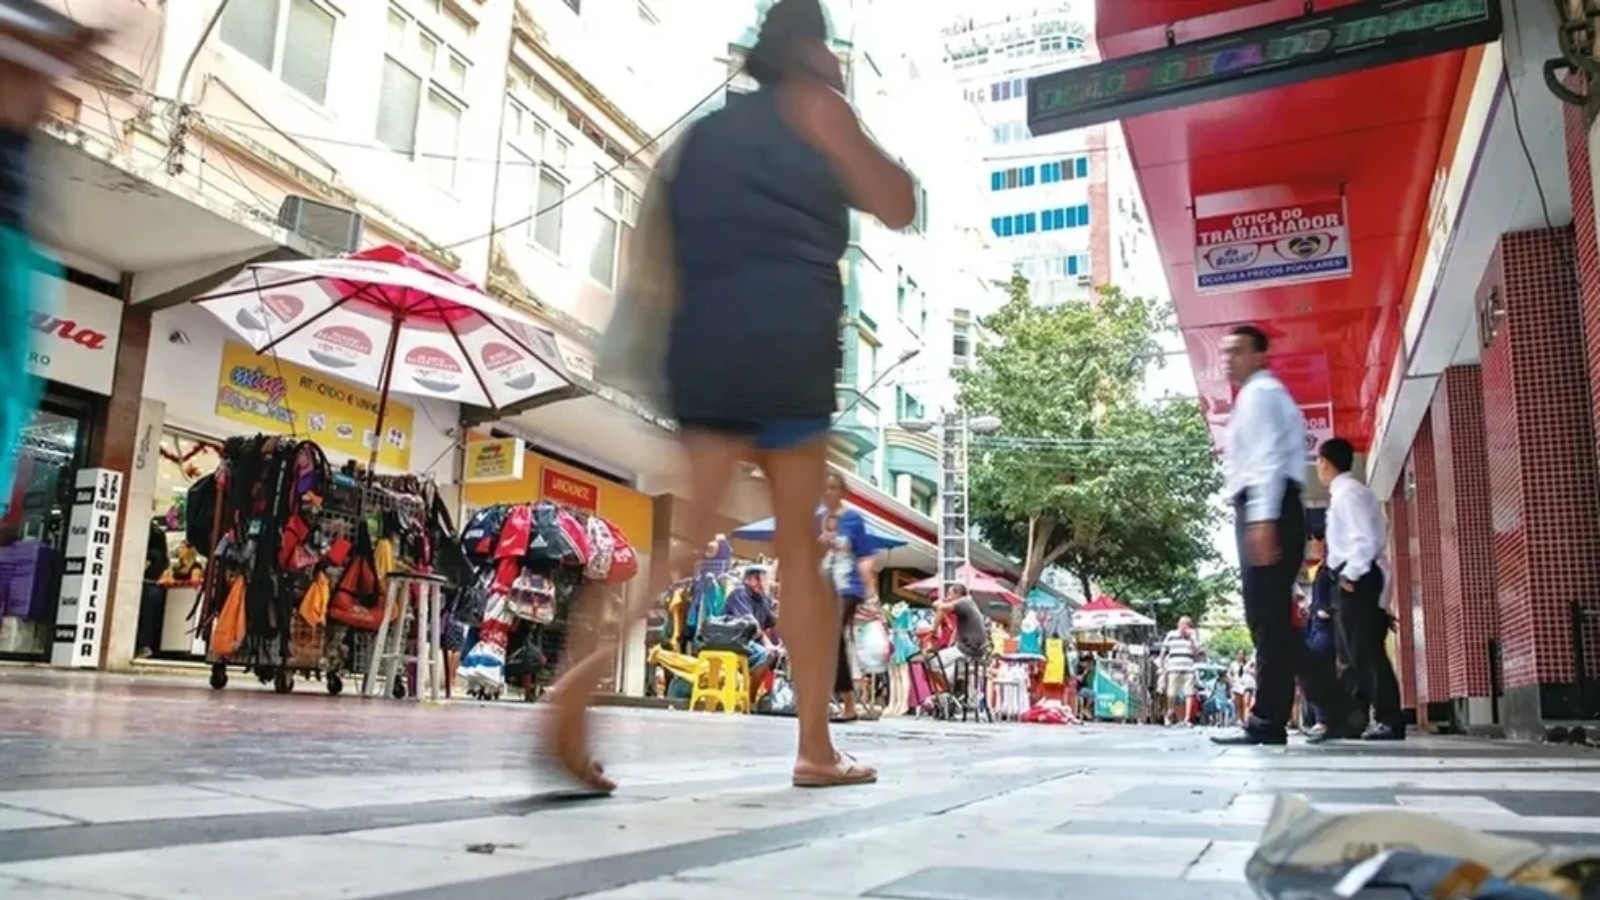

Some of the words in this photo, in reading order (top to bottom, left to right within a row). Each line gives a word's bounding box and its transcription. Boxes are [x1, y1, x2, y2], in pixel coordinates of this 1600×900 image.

[1199, 213, 1339, 245] TRABALHADOR
[1232, 210, 1277, 228] ÓTICA
[1281, 208, 1303, 220] DO
